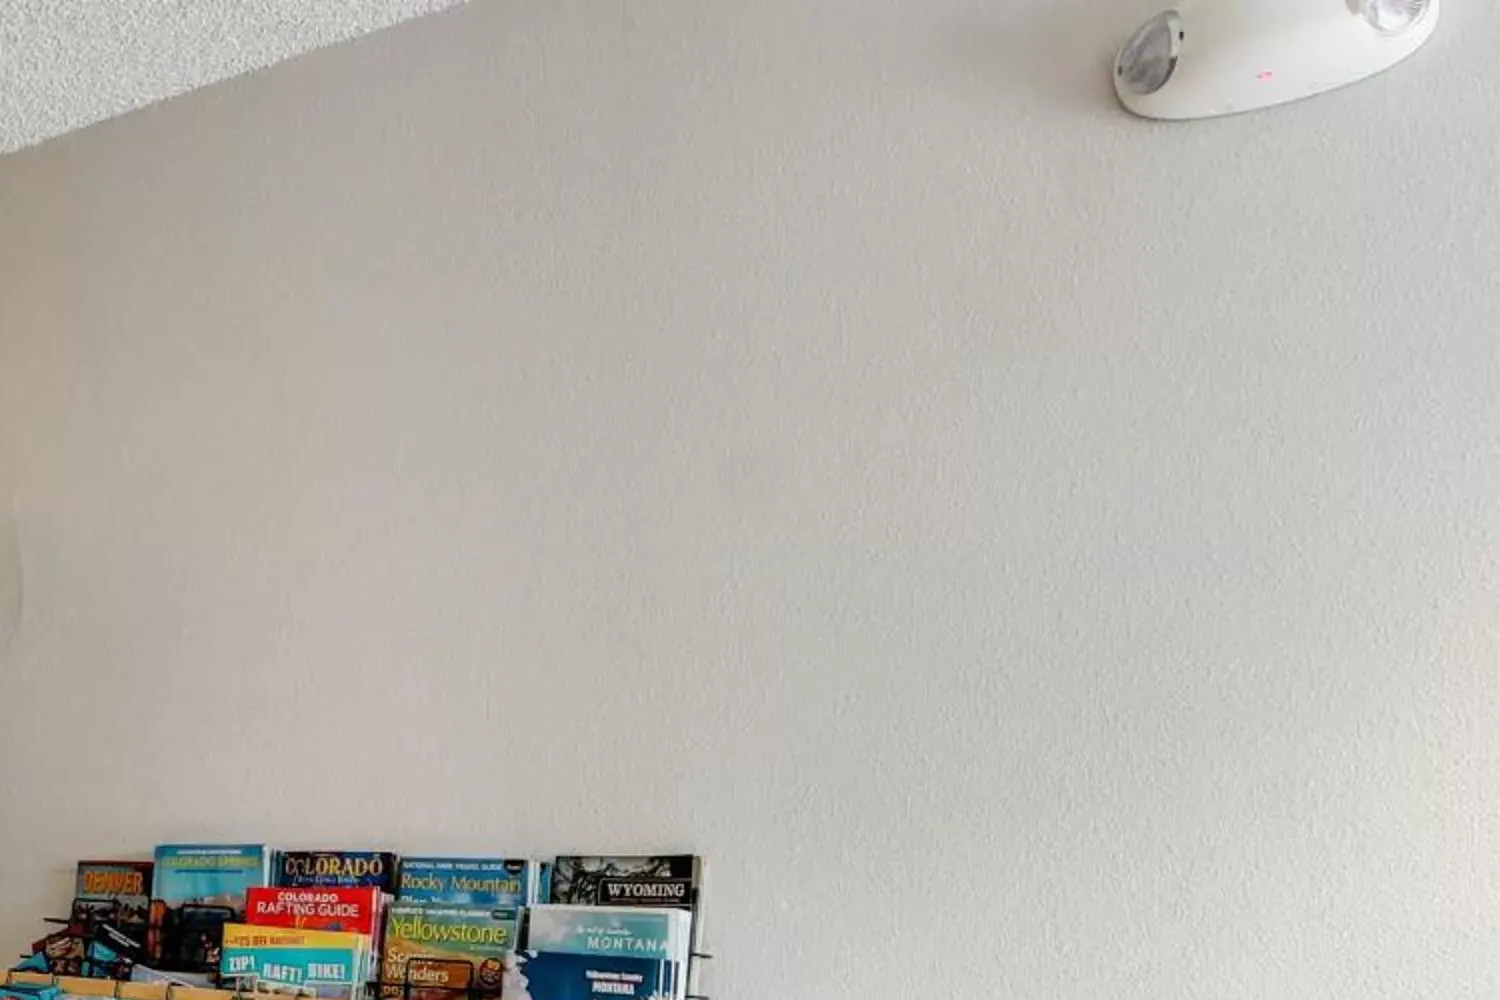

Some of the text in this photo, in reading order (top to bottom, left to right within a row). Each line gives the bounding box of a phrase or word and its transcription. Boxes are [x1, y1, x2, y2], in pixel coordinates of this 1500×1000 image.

[286, 857, 383, 876] COLORADO
[84, 871, 143, 895] DENVER
[402, 873, 520, 893] Rocky Mountain
[607, 883, 685, 897] WYOMING
[278, 892, 338, 904] COLORADO
[257, 902, 360, 917] RAFTING GUIDE
[391, 917, 507, 944] Yellowstone
[587, 936, 667, 951] MONTANA
[228, 956, 255, 971] ZIP!
[308, 963, 345, 979] BIKE!
[263, 964, 303, 983] RAFT!
